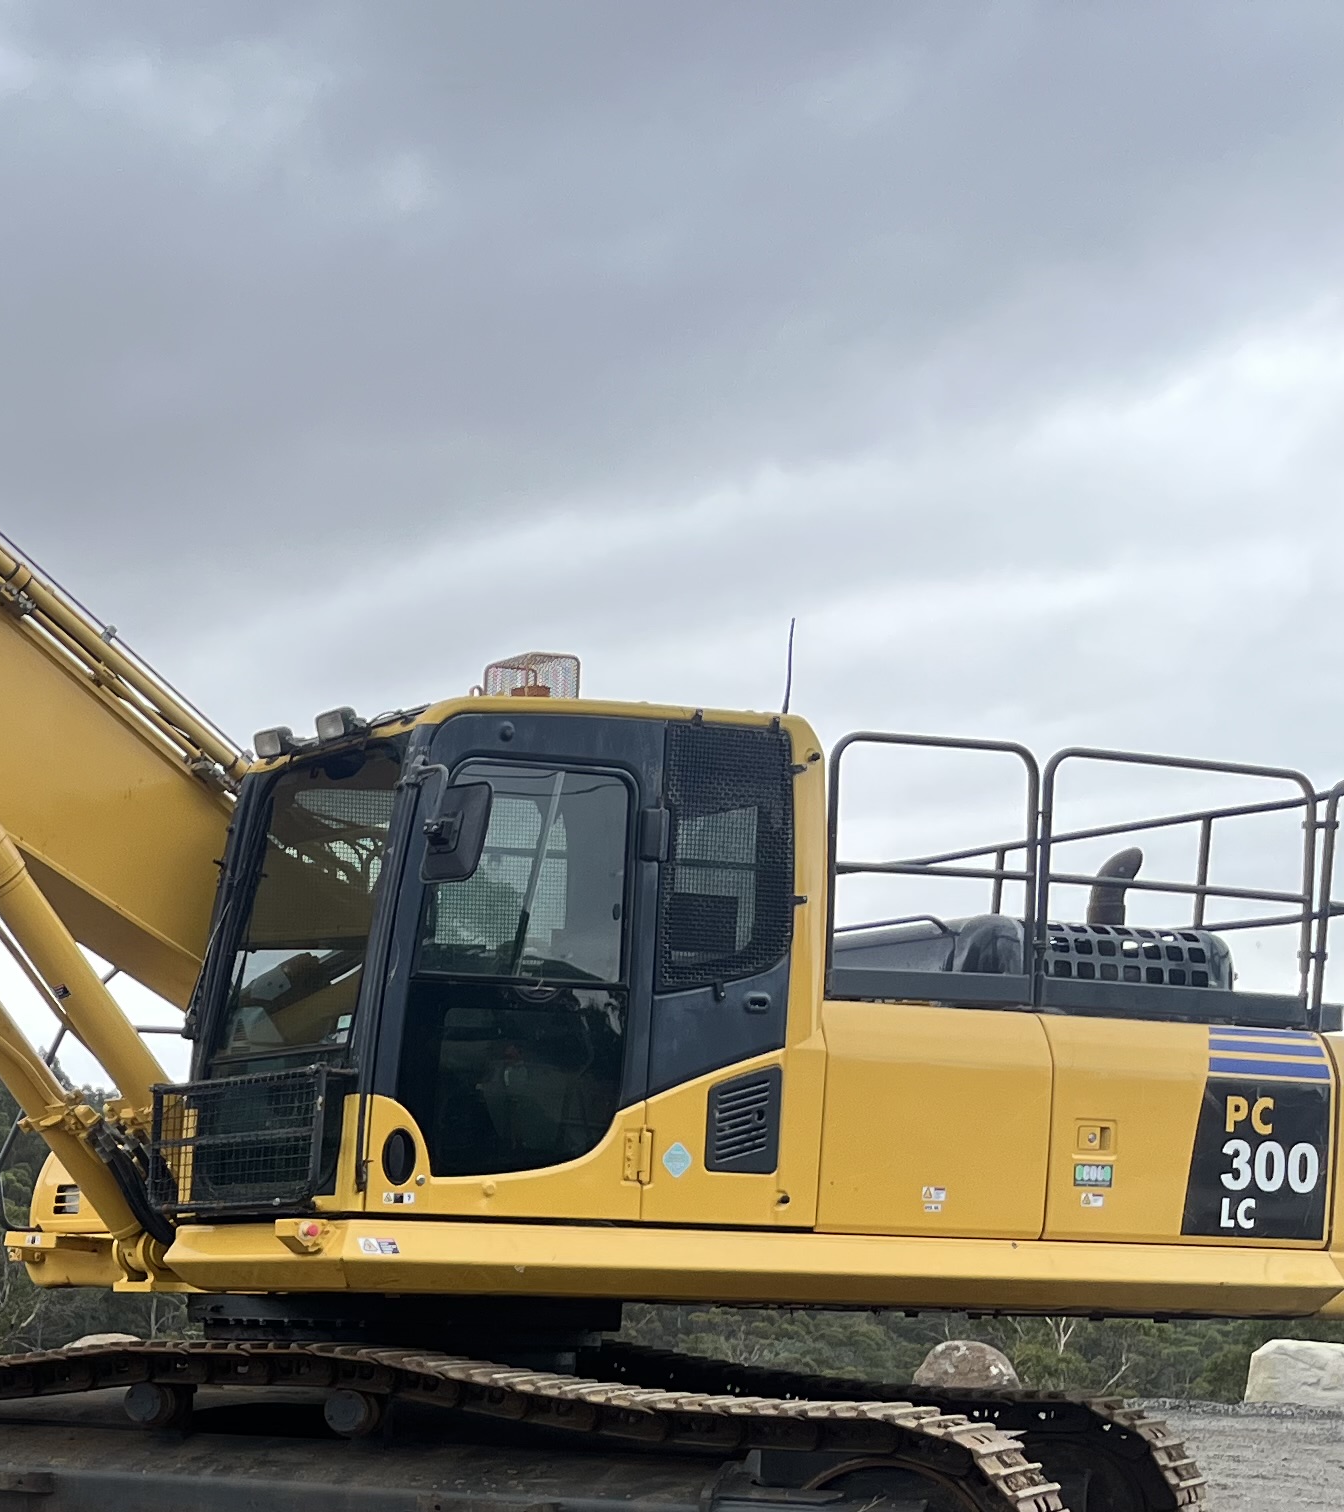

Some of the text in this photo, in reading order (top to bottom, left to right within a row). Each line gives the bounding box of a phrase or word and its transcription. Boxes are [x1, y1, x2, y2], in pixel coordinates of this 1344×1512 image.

[1225, 1095, 1274, 1135] PC
[1220, 1138, 1319, 1194] 300
[1220, 1197, 1256, 1229] LC
